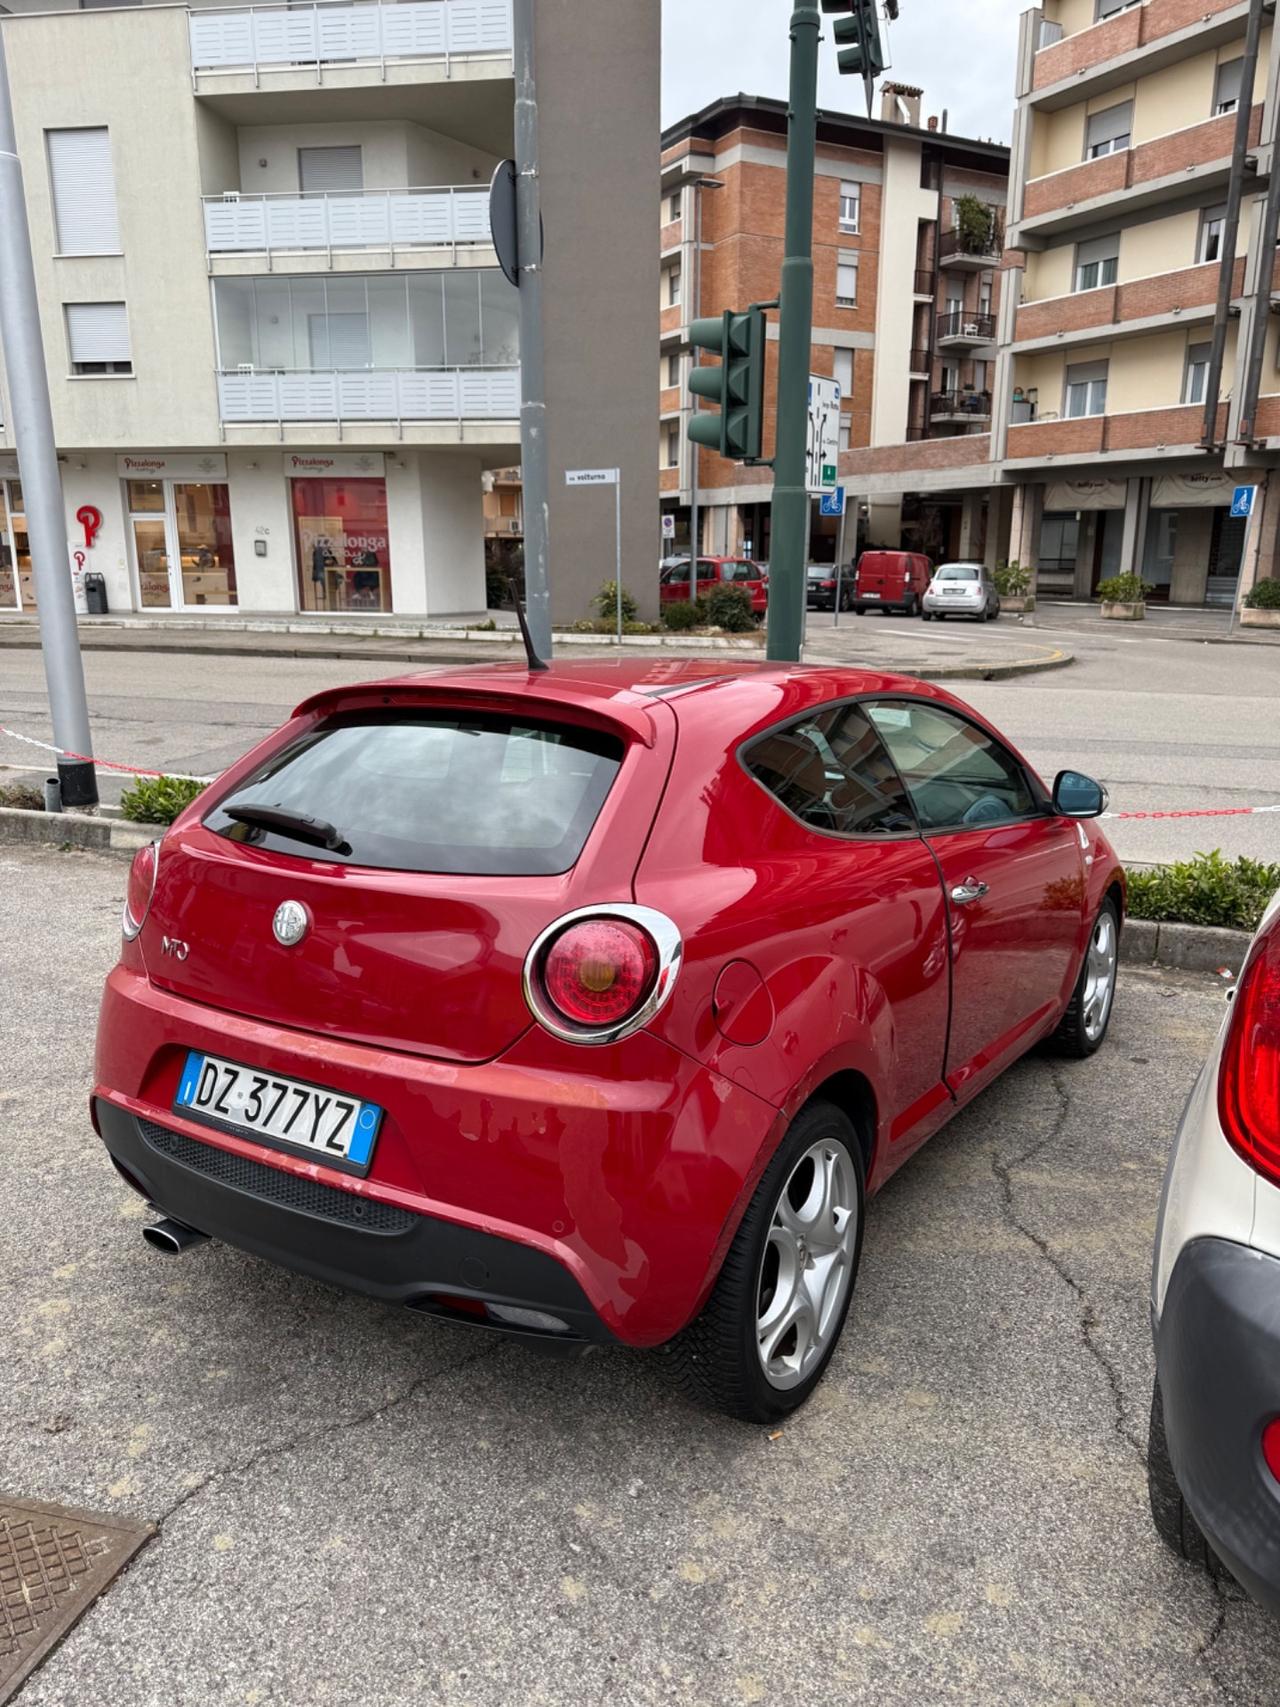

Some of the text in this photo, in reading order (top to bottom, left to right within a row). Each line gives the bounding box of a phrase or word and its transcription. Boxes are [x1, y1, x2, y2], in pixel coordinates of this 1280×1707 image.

[124, 457, 165, 470] Pizzalonga
[292, 456, 334, 468] Pizzalonga
[302, 529, 387, 553] Pizzalonga
[196, 1062, 240, 1115] DZ
[244, 1076, 355, 1151] 377YZ
